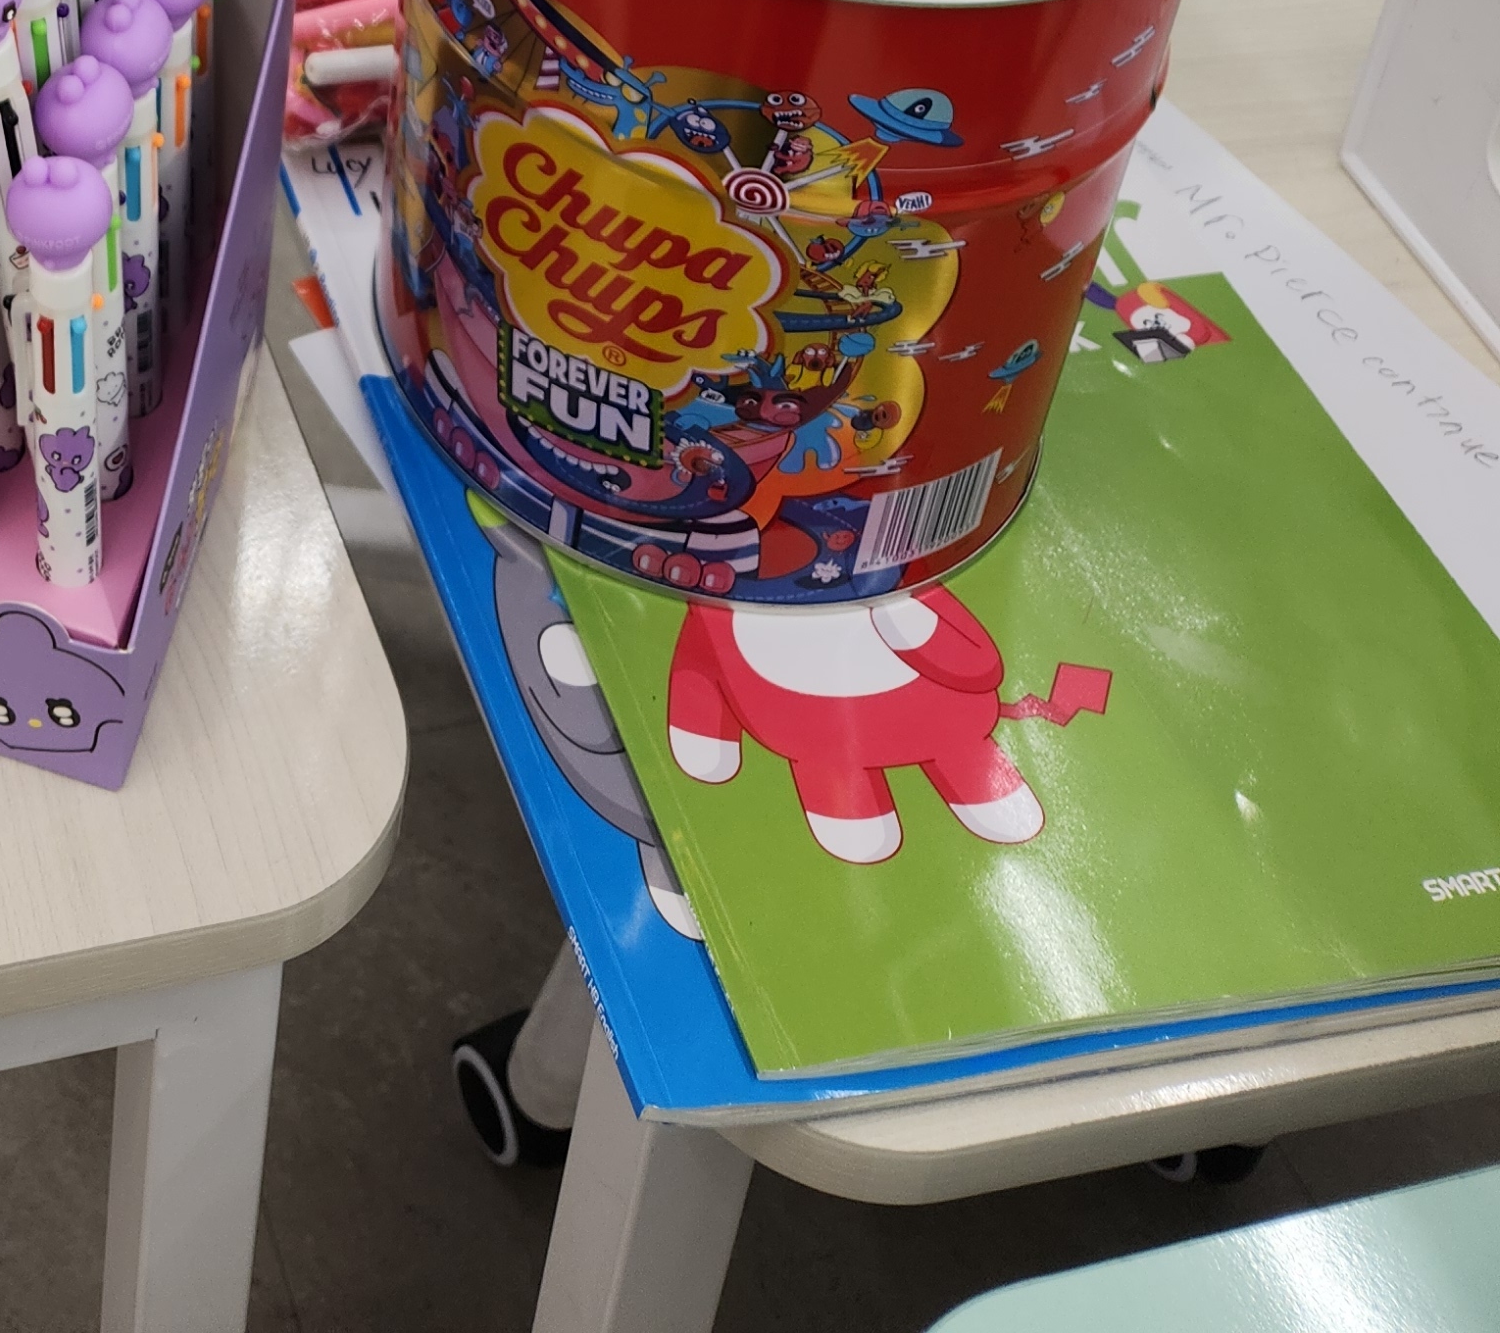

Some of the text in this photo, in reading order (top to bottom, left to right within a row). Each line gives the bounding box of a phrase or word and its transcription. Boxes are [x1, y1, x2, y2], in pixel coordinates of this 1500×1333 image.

[503, 142, 753, 291] Chupa
[899, 194, 930, 210] YEAH!
[485, 196, 728, 364] Chups
[511, 358, 651, 452] FUN
[512, 328, 650, 415] FOREVER
[1423, 867, 1500, 903] SMART
